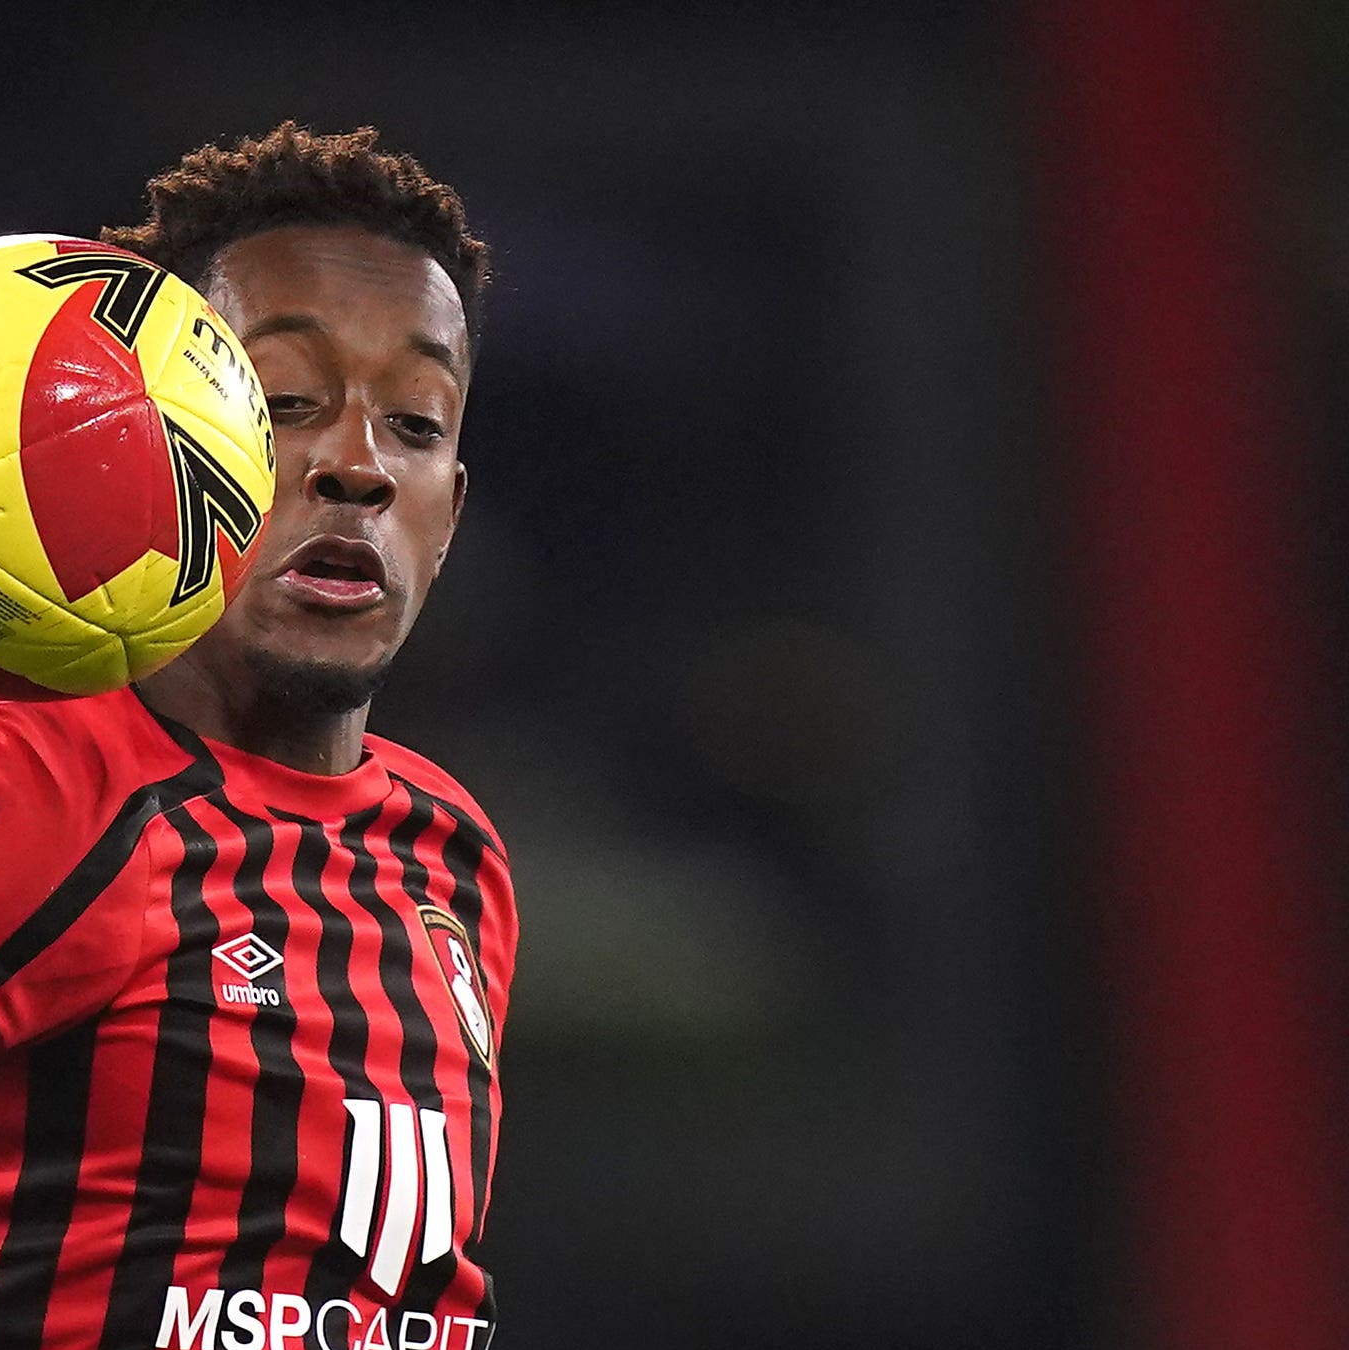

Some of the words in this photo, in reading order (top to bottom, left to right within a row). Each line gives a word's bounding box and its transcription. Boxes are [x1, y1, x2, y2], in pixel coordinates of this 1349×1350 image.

[183, 350, 211, 379] DELTA
[209, 377, 229, 401] MAX
[222, 981, 280, 1006] umbro
